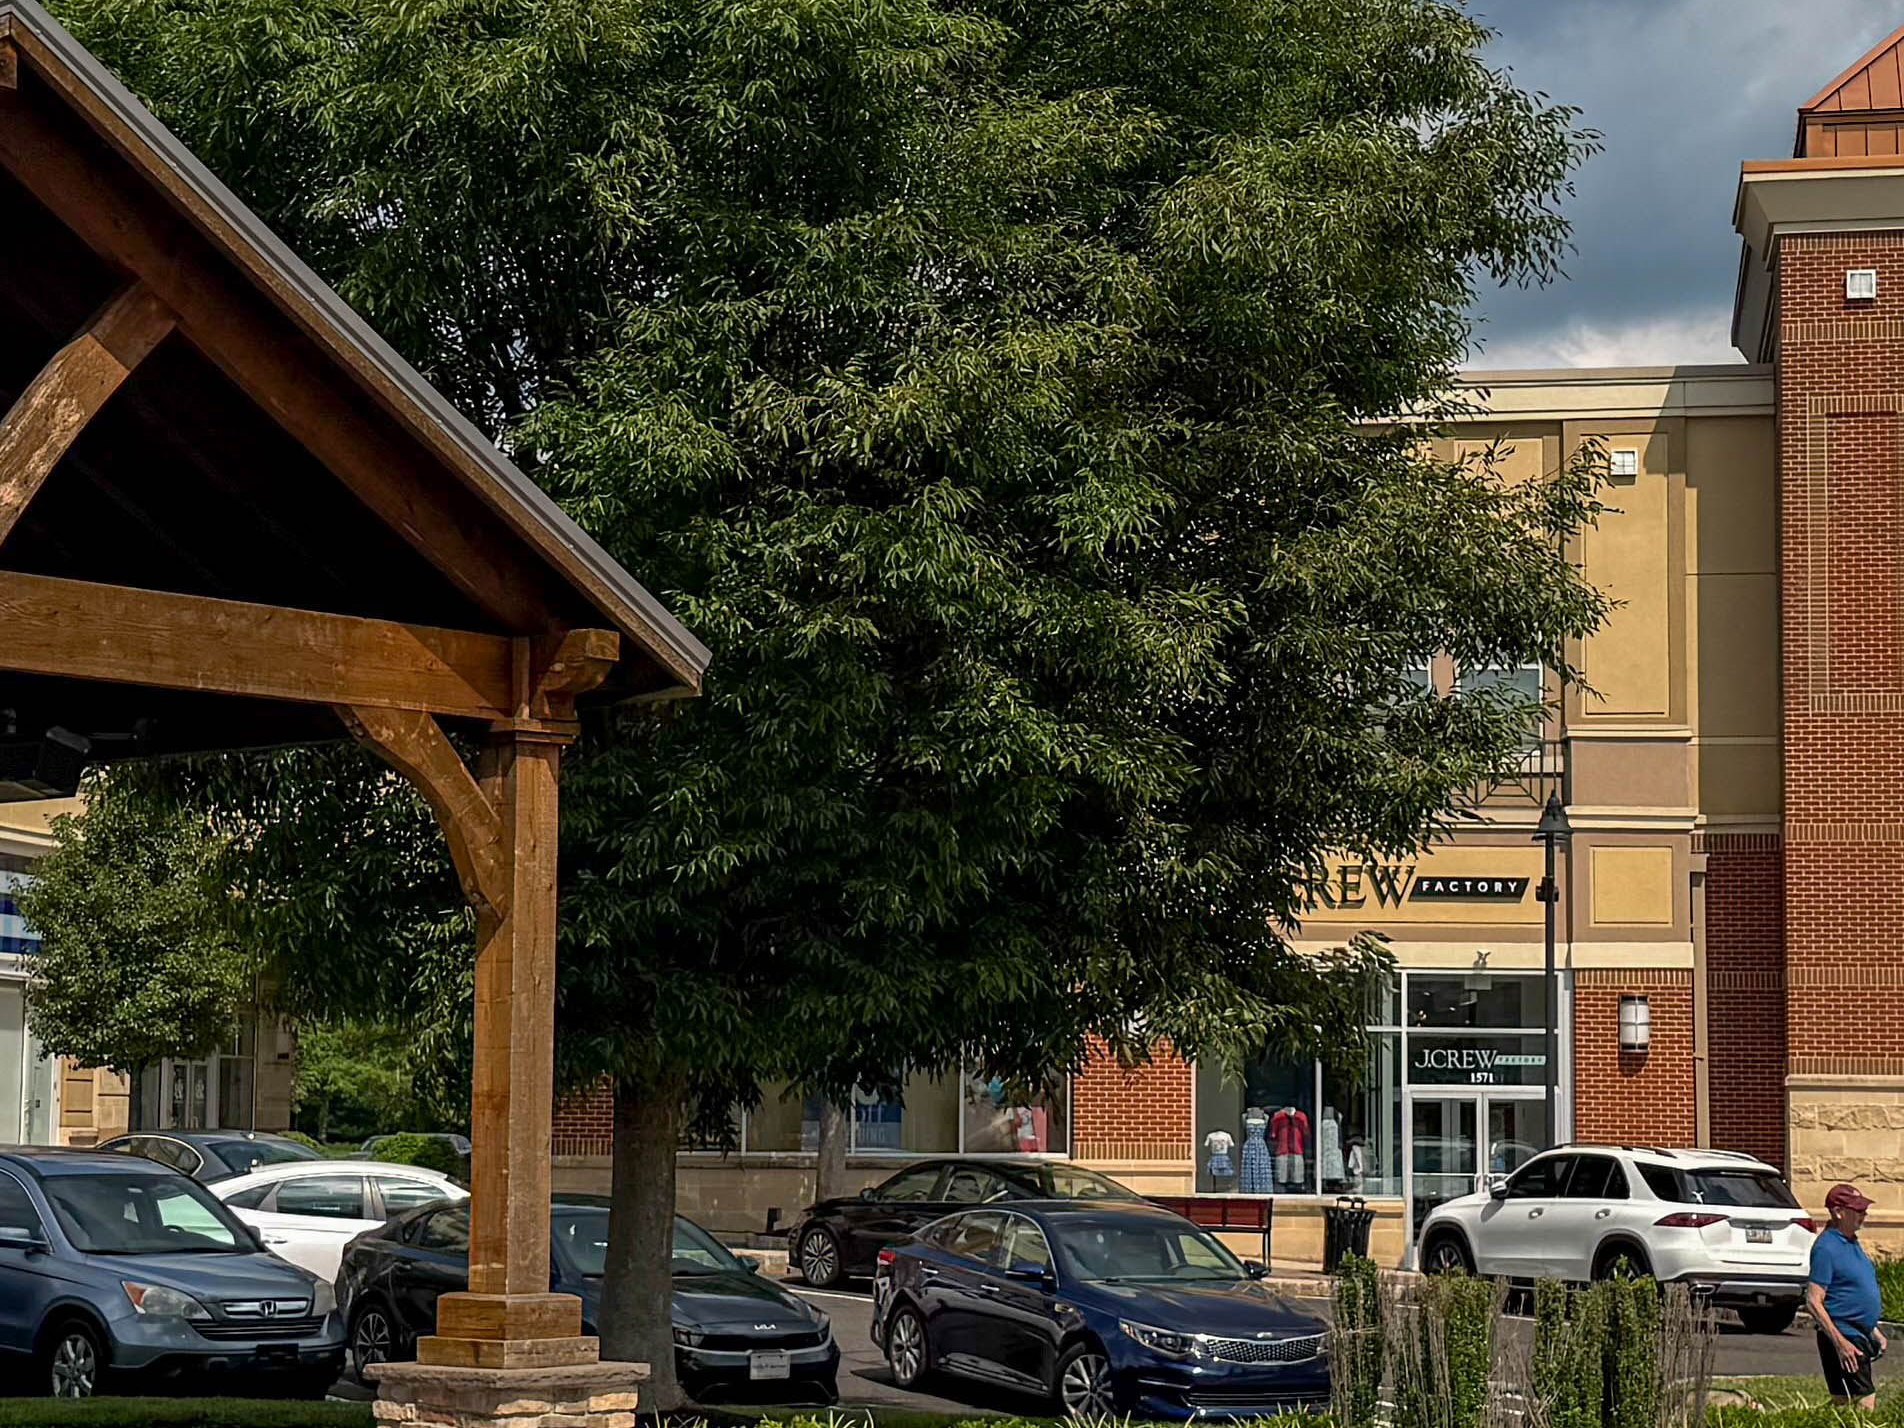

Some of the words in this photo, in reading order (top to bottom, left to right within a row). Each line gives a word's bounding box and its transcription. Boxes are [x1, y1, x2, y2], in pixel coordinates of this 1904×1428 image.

[1301, 864, 1417, 910] REW
[1421, 880, 1518, 893] FACTORY
[1414, 1048, 1498, 1069] J.CREW
[1470, 1072, 1494, 1084] 1571
